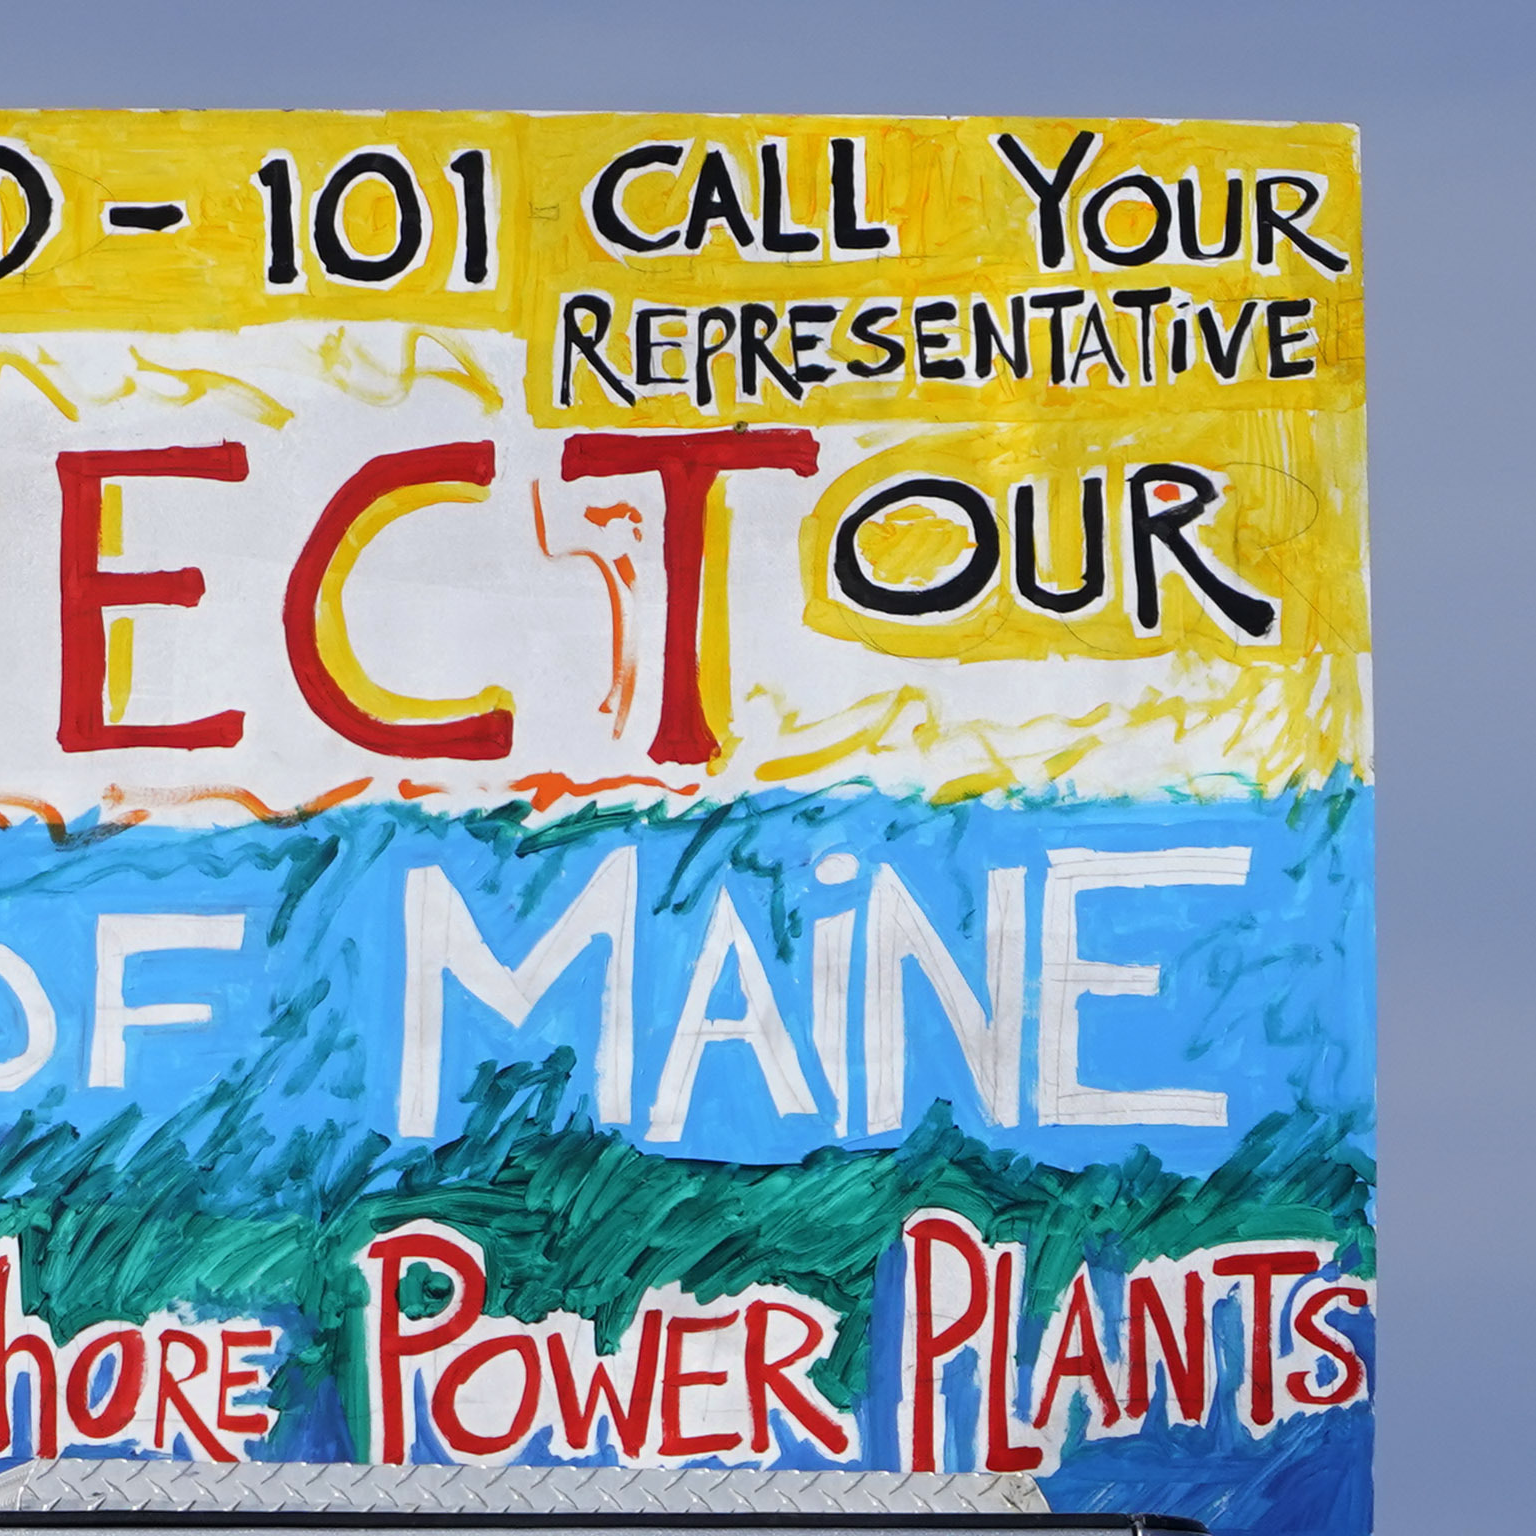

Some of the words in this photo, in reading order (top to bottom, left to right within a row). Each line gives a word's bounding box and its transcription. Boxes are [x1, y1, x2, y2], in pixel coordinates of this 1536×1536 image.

[259, 149, 490, 285] 101
[591, 136, 891, 253] CALL
[998, 130, 1348, 274] YOUR
[833, 463, 1274, 637] OUR
[367, 1233, 849, 1465] POWER
[906, 1217, 1368, 1473] PLANTS
